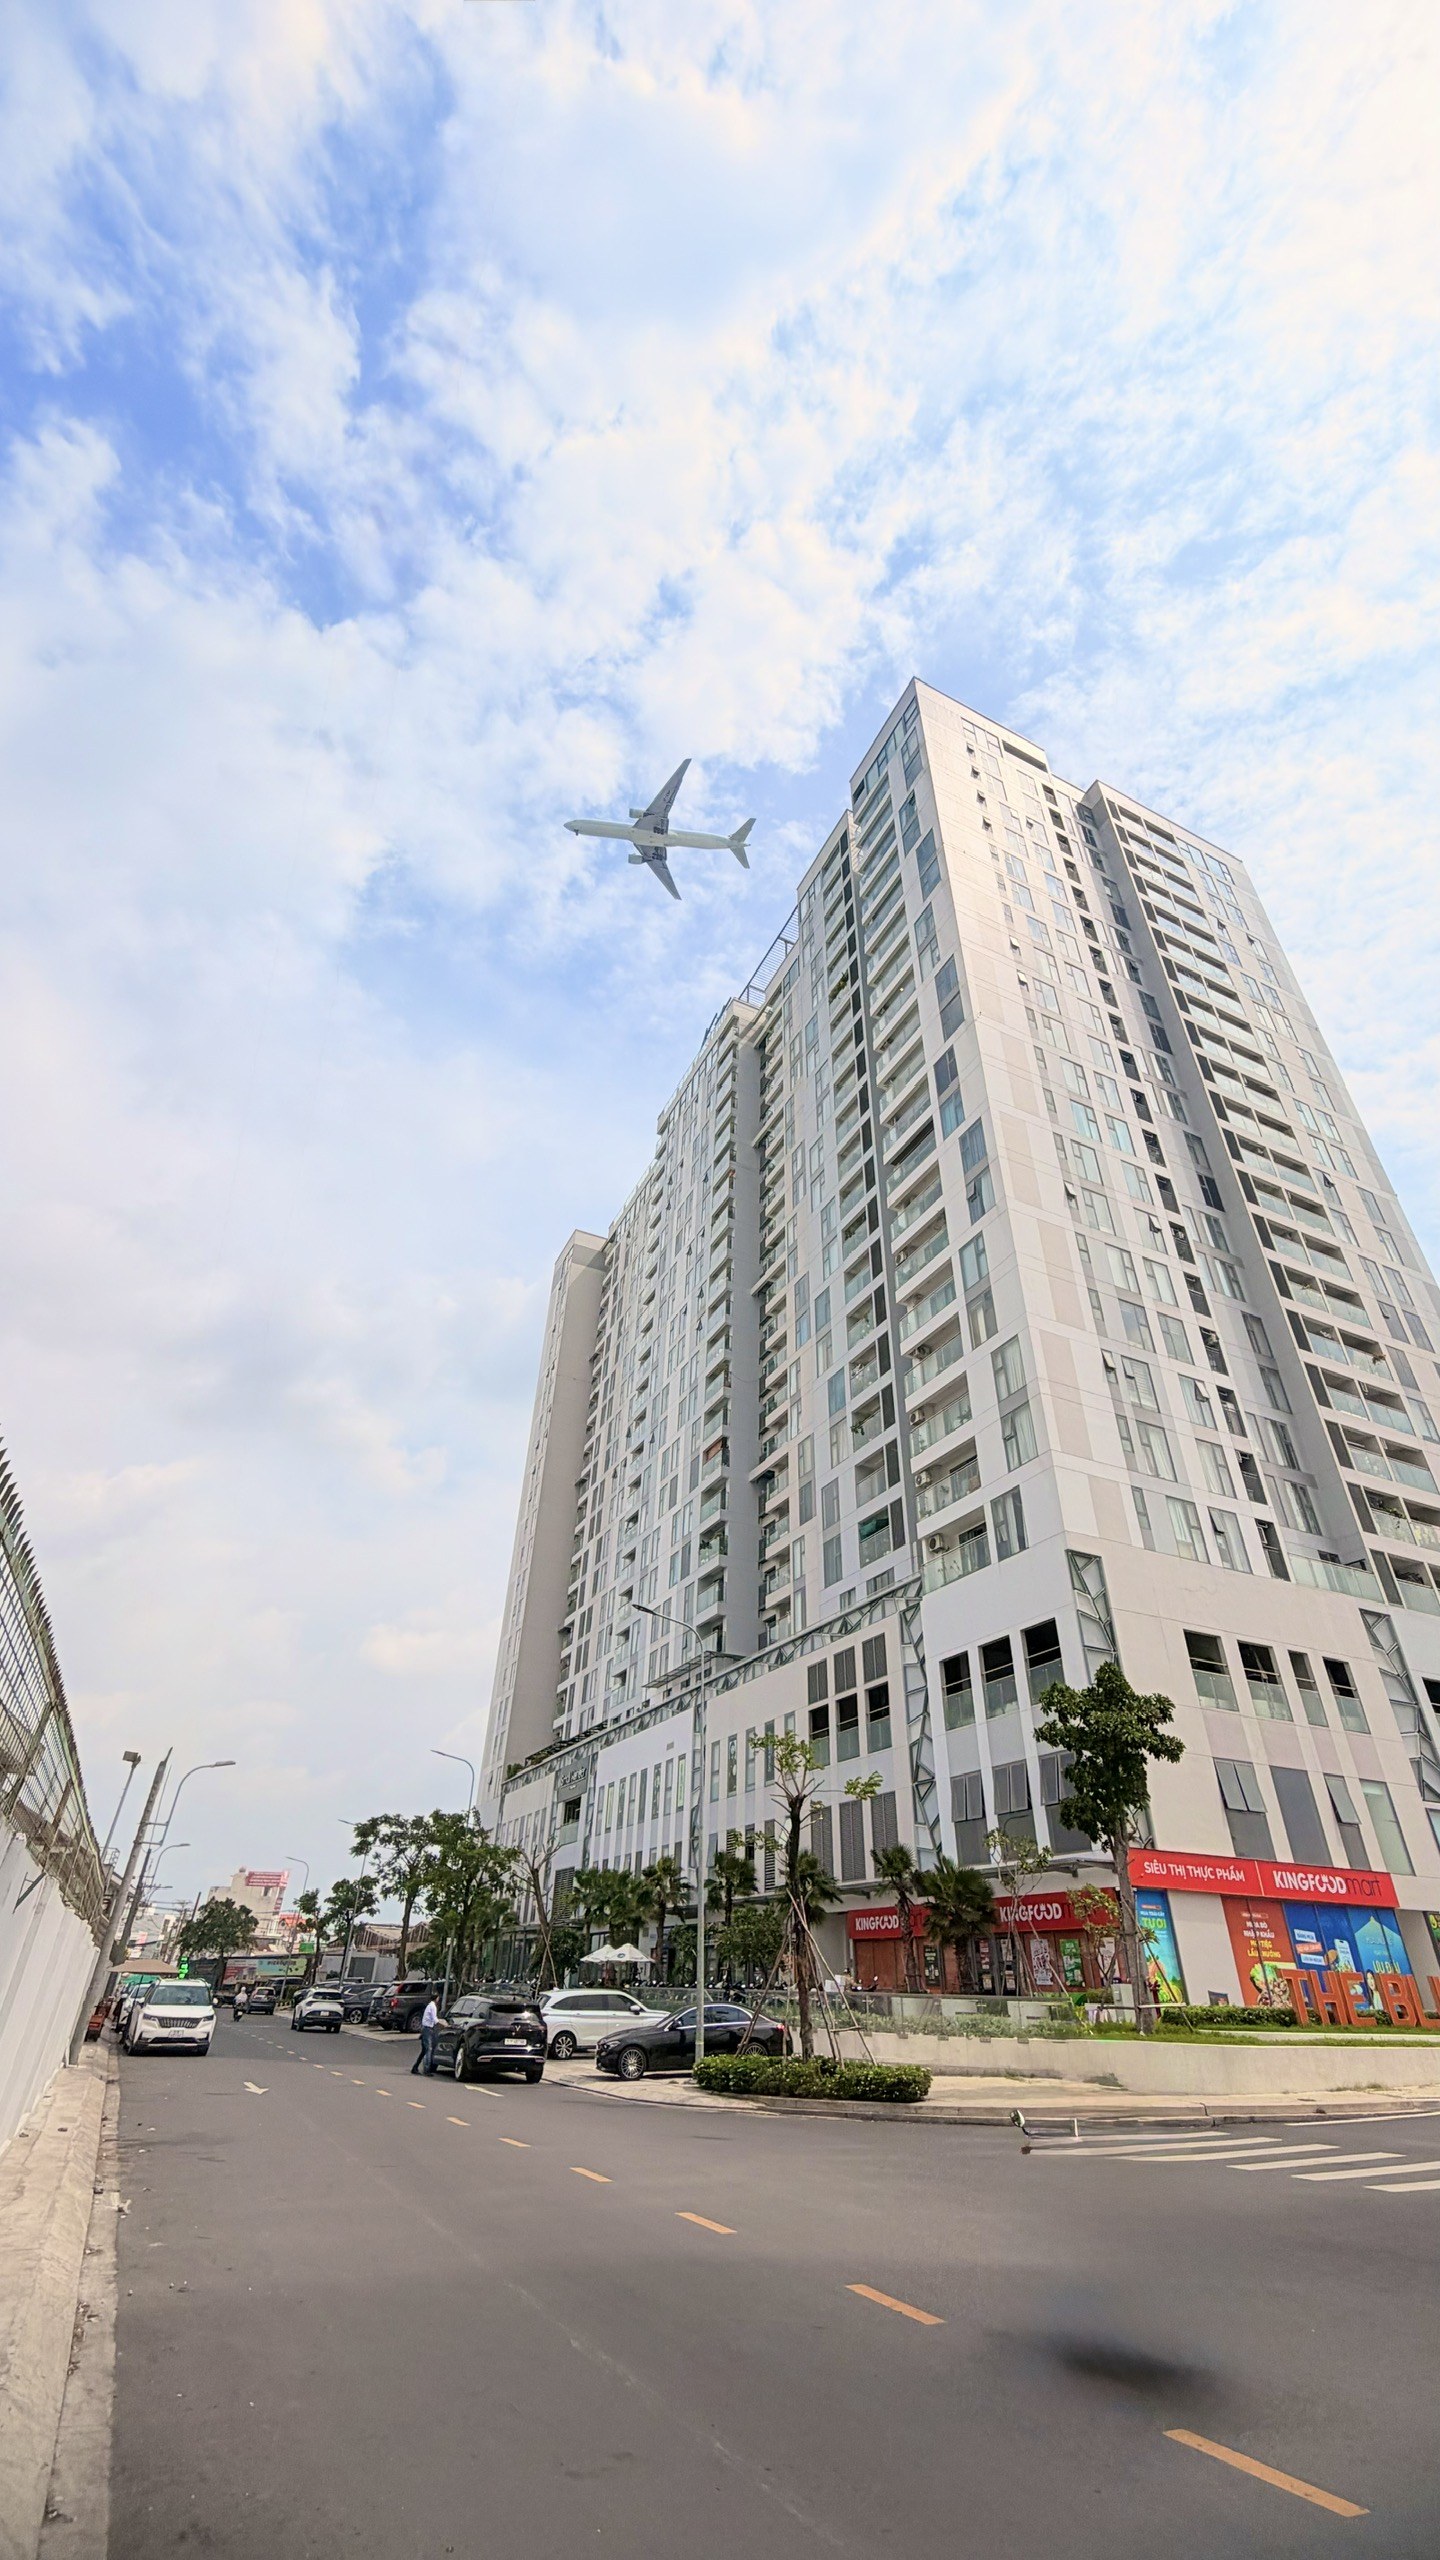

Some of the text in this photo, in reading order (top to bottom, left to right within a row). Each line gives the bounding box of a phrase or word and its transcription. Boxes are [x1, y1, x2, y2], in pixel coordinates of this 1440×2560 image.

[1144, 1859, 1246, 1882] SIÊU THỊ THỰC PHẨM
[1277, 1969, 1378, 2027] THE
